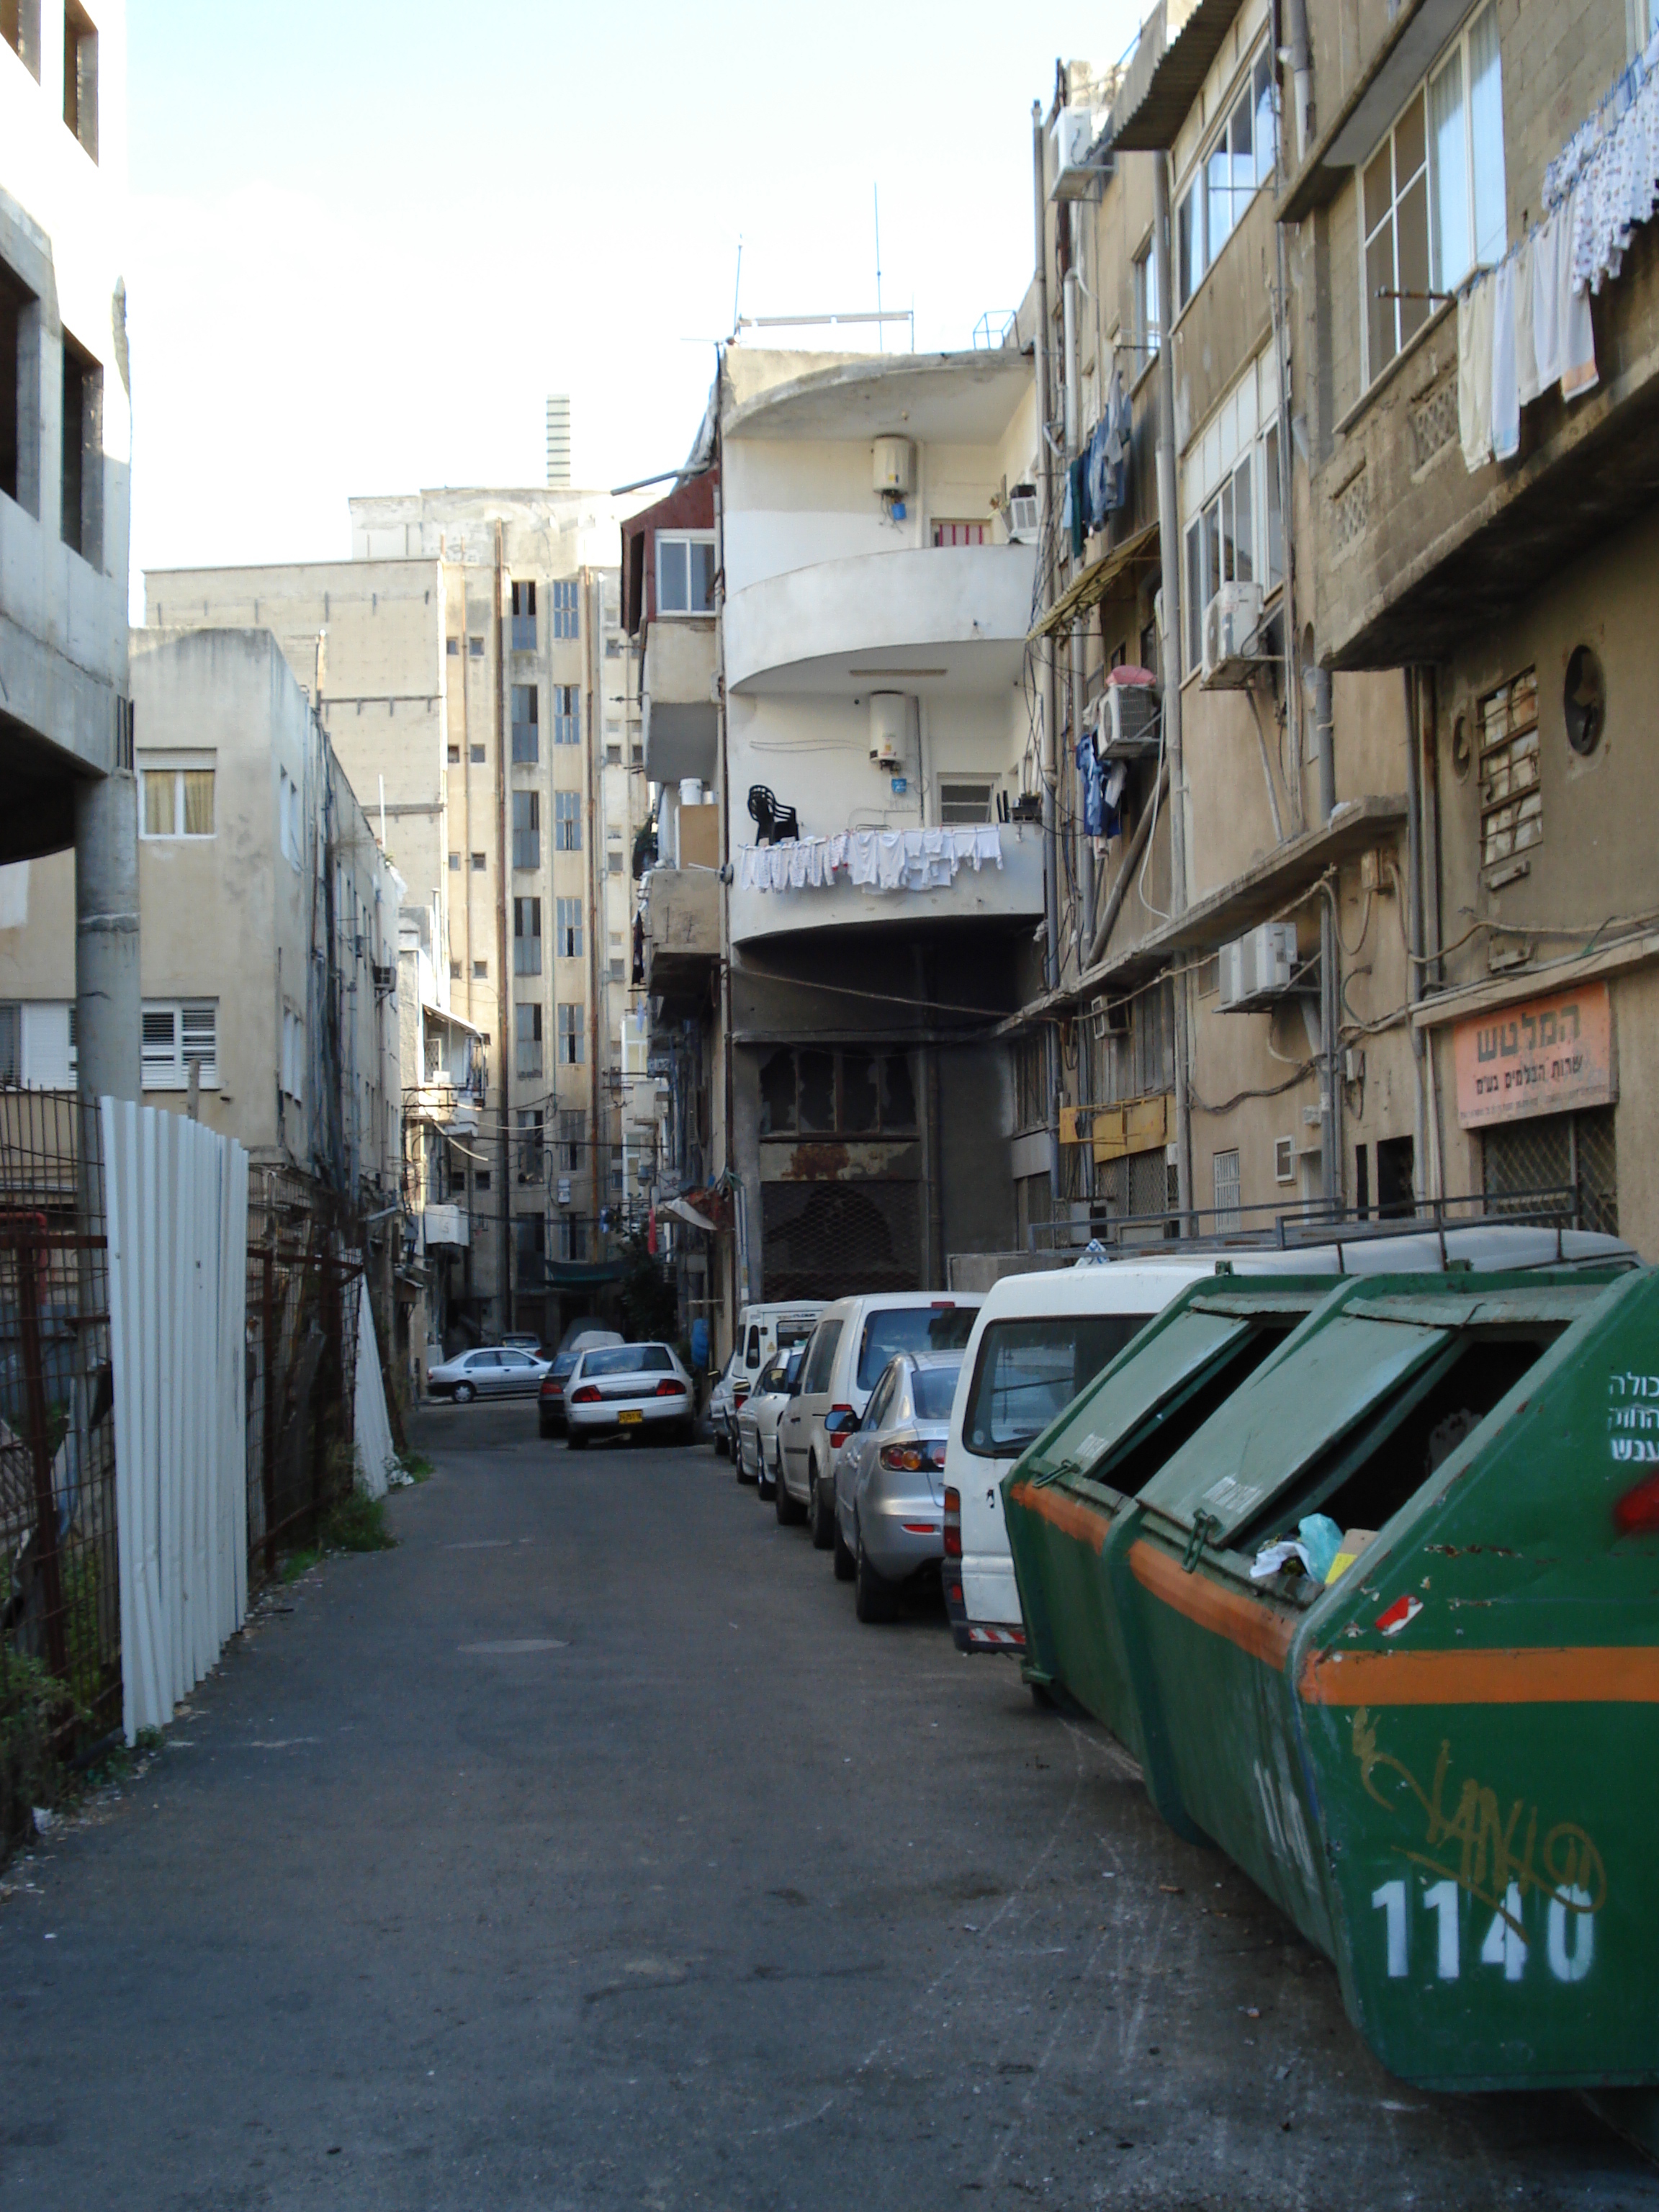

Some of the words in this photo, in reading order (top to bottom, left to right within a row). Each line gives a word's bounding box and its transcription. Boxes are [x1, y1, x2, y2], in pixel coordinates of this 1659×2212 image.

[1478, 1004, 1581, 1063] המלטש
[1550, 1054, 1583, 1079] שרות
[1371, 1879, 1594, 1982] 1140
